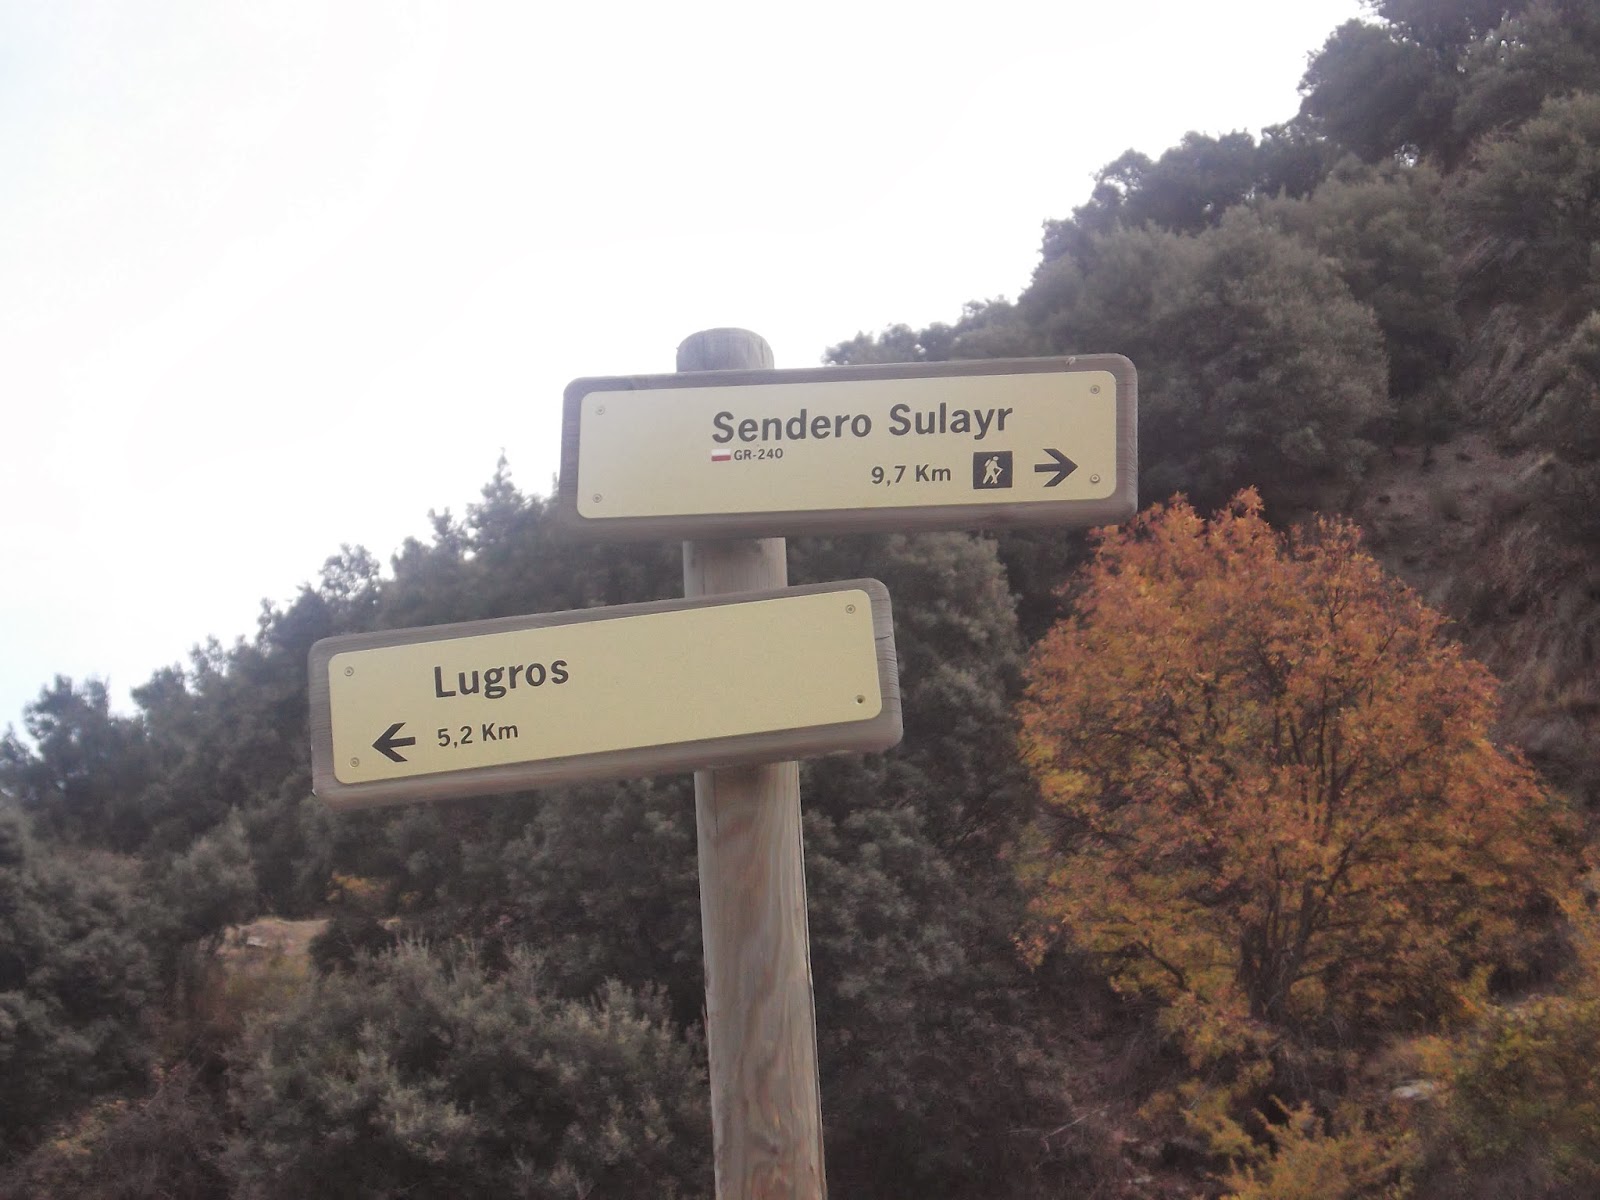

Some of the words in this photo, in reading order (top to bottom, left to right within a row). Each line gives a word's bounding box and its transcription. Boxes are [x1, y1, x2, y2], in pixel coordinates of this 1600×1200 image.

[712, 408, 872, 443] Sendero
[888, 402, 1013, 441] Sulayr
[733, 448, 784, 461] GR-240
[871, 465, 907, 487] 9,7
[915, 464, 951, 483] Km
[434, 660, 569, 700] Lugros
[437, 725, 473, 749] 5,2
[481, 722, 519, 742] Km
